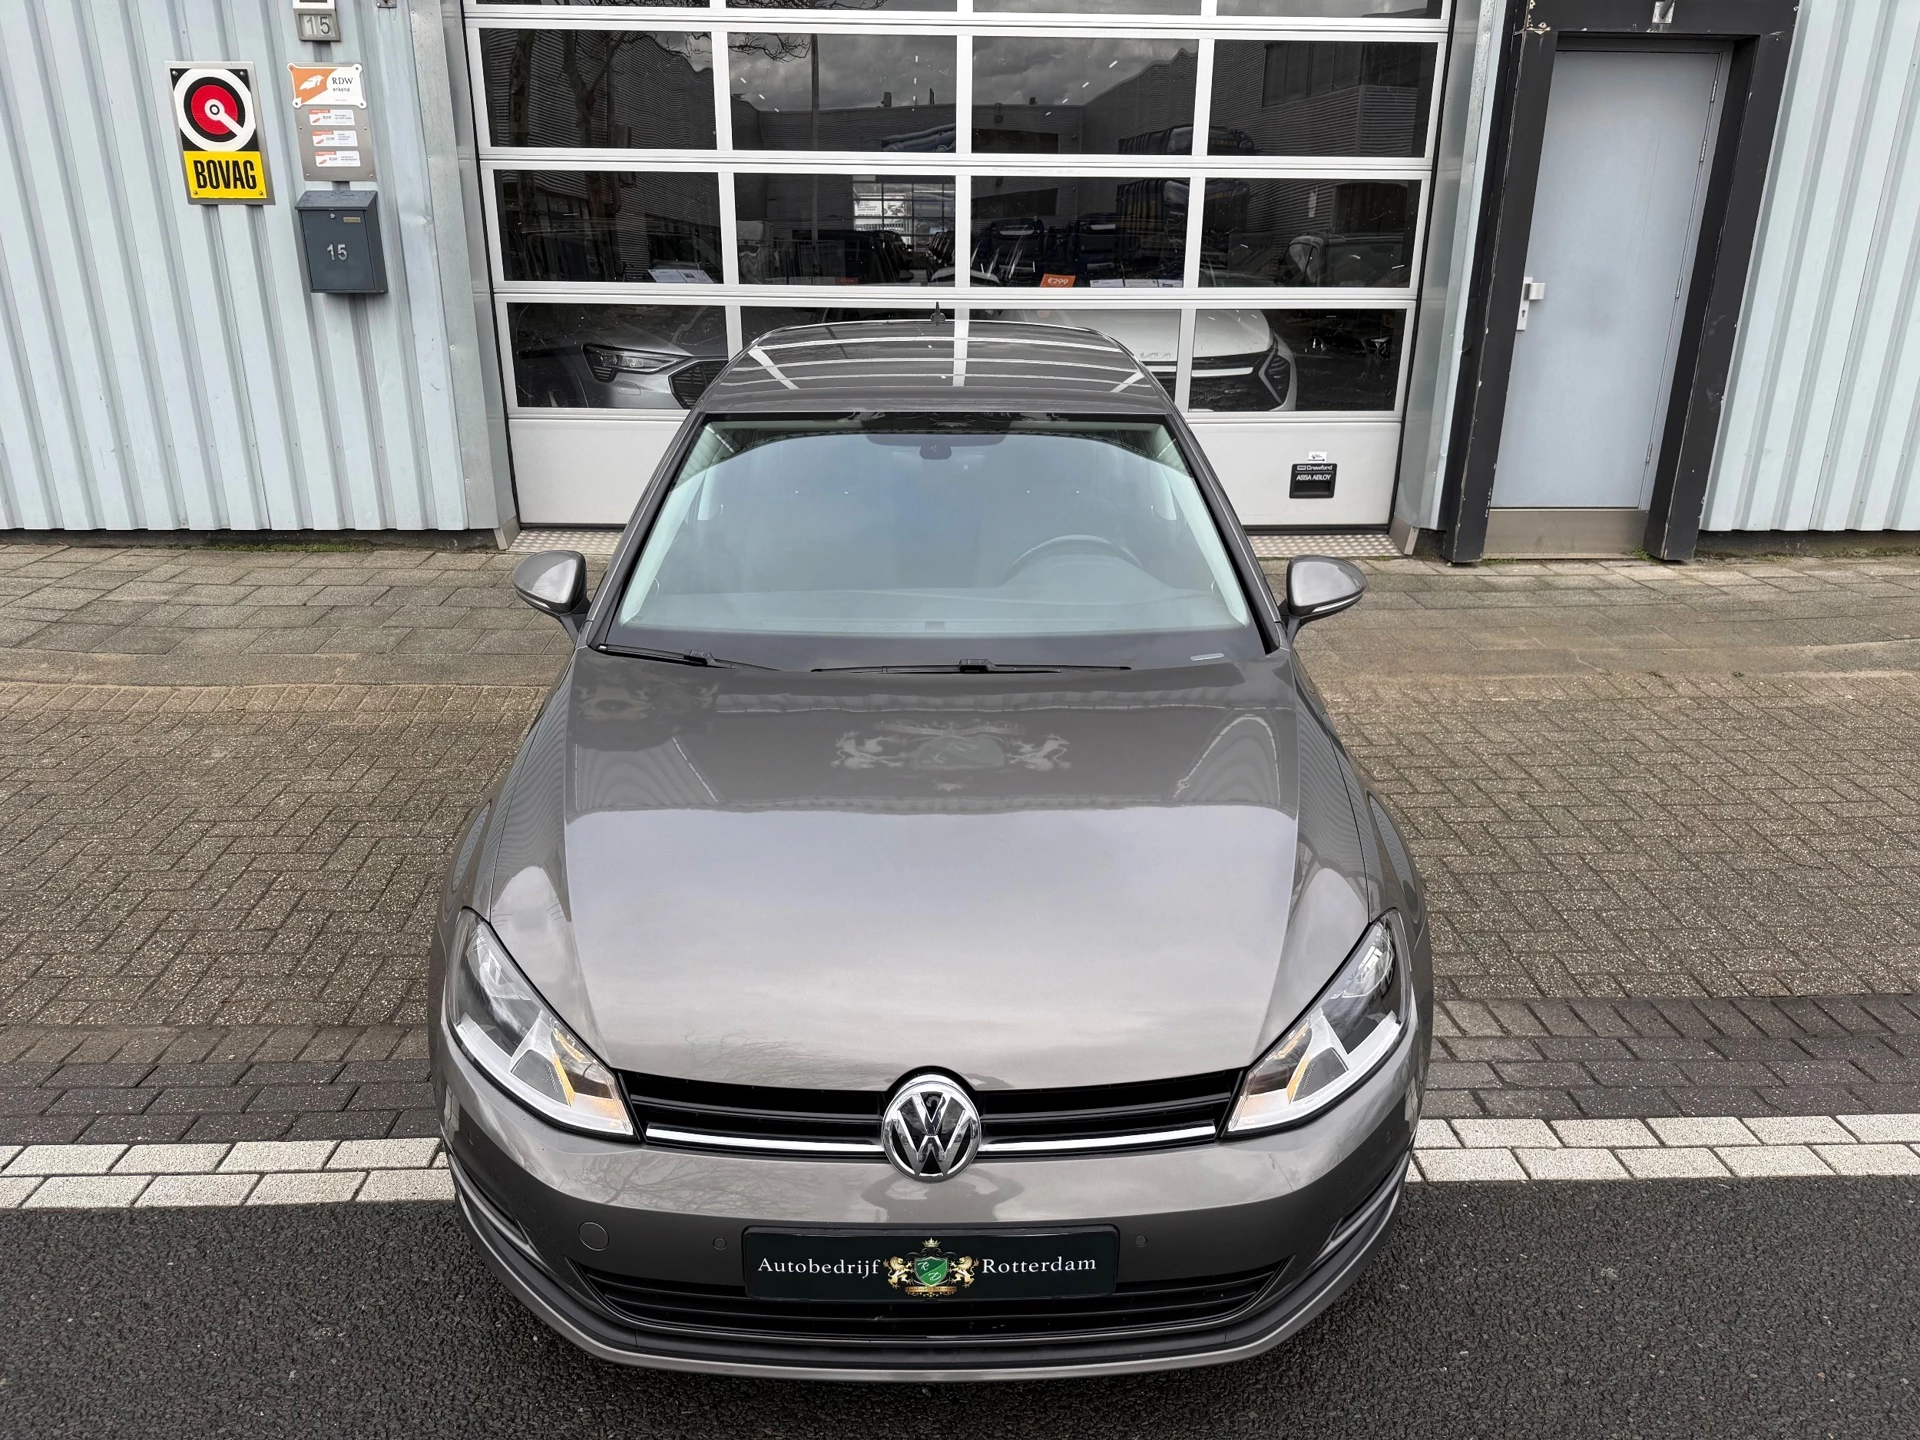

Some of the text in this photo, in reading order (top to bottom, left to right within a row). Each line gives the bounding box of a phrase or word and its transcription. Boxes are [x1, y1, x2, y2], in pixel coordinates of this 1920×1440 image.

[306, 16, 330, 35] 15
[331, 77, 353, 85] RDW
[193, 159, 257, 190] BOVAG
[327, 243, 348, 261] 15
[1047, 277, 1069, 285] €299
[757, 1256, 1097, 1279] Autobedrijf Rotterdam
